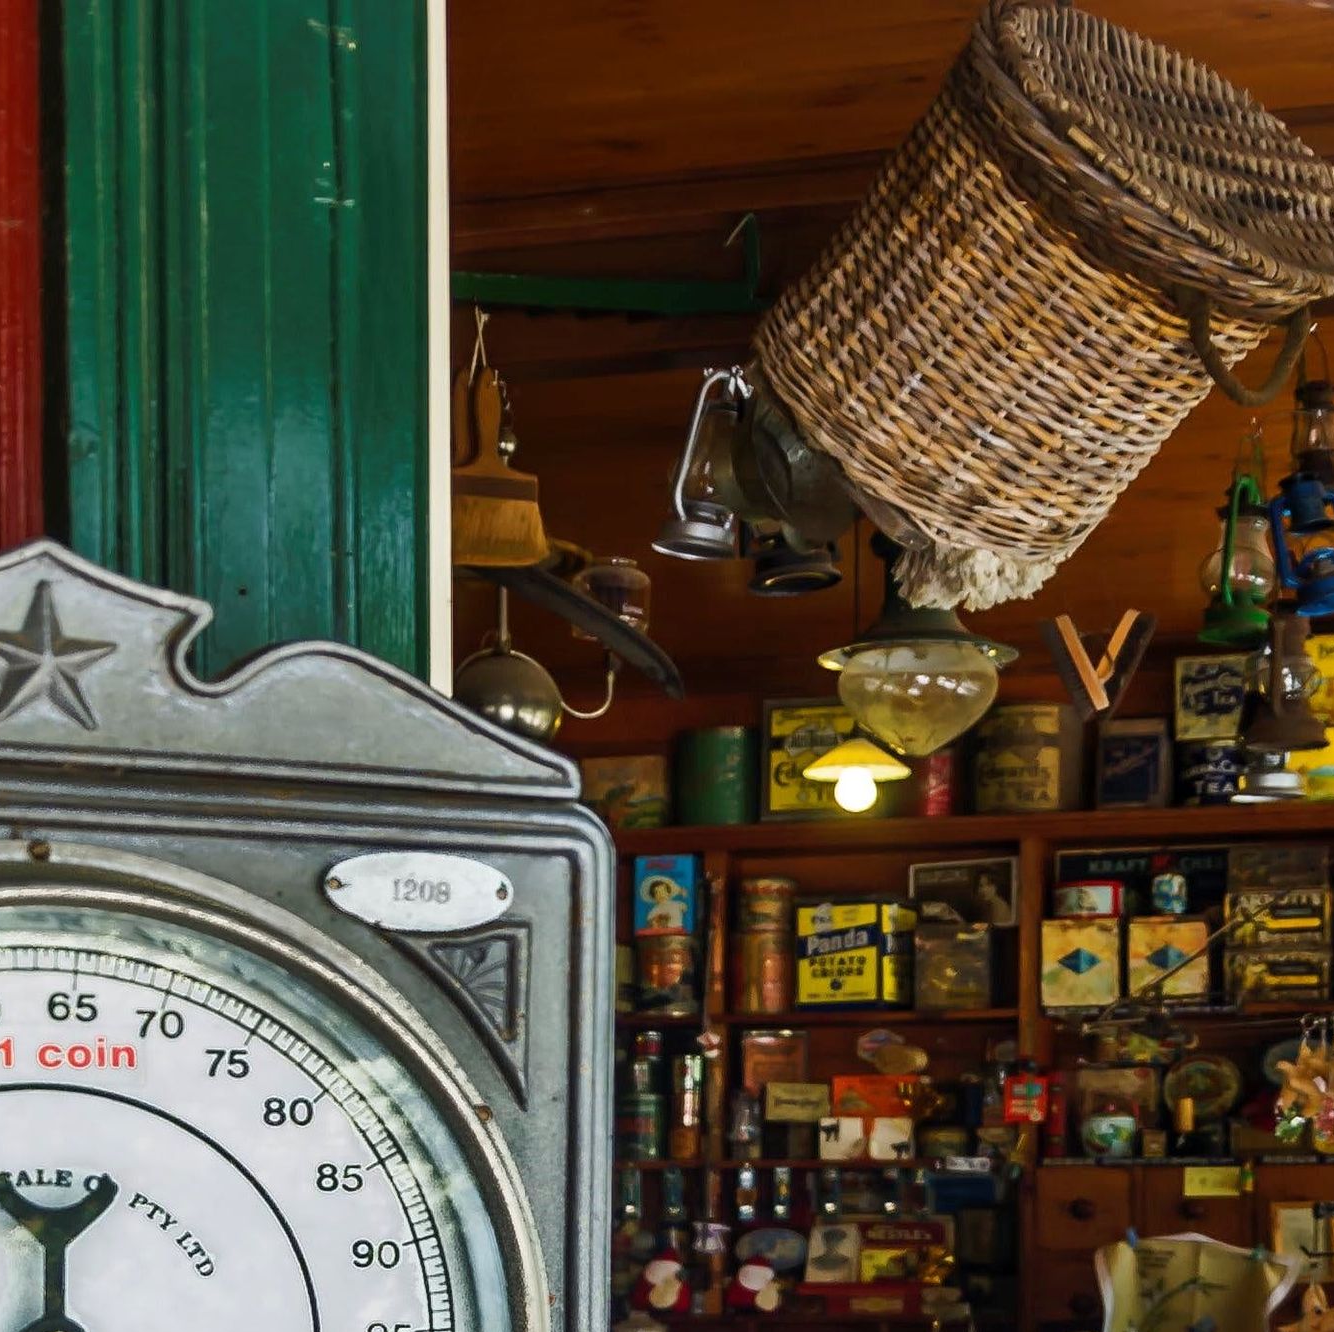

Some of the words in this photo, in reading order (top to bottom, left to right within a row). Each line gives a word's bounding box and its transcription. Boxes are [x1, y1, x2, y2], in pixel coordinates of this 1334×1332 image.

[1088, 858, 1149, 873] KRAFT
[391, 876, 451, 905] 1208
[806, 927, 870, 956] Panda
[47, 992, 98, 1022] 65
[135, 1010, 184, 1039] 70
[36, 1035, 139, 1070] coin
[205, 1049, 250, 1079] 75
[263, 1098, 314, 1128] 80
[316, 1163, 364, 1193] 85
[128, 1192, 178, 1235] PTY
[175, 1229, 219, 1280] LTD
[352, 1239, 401, 1270] 90
